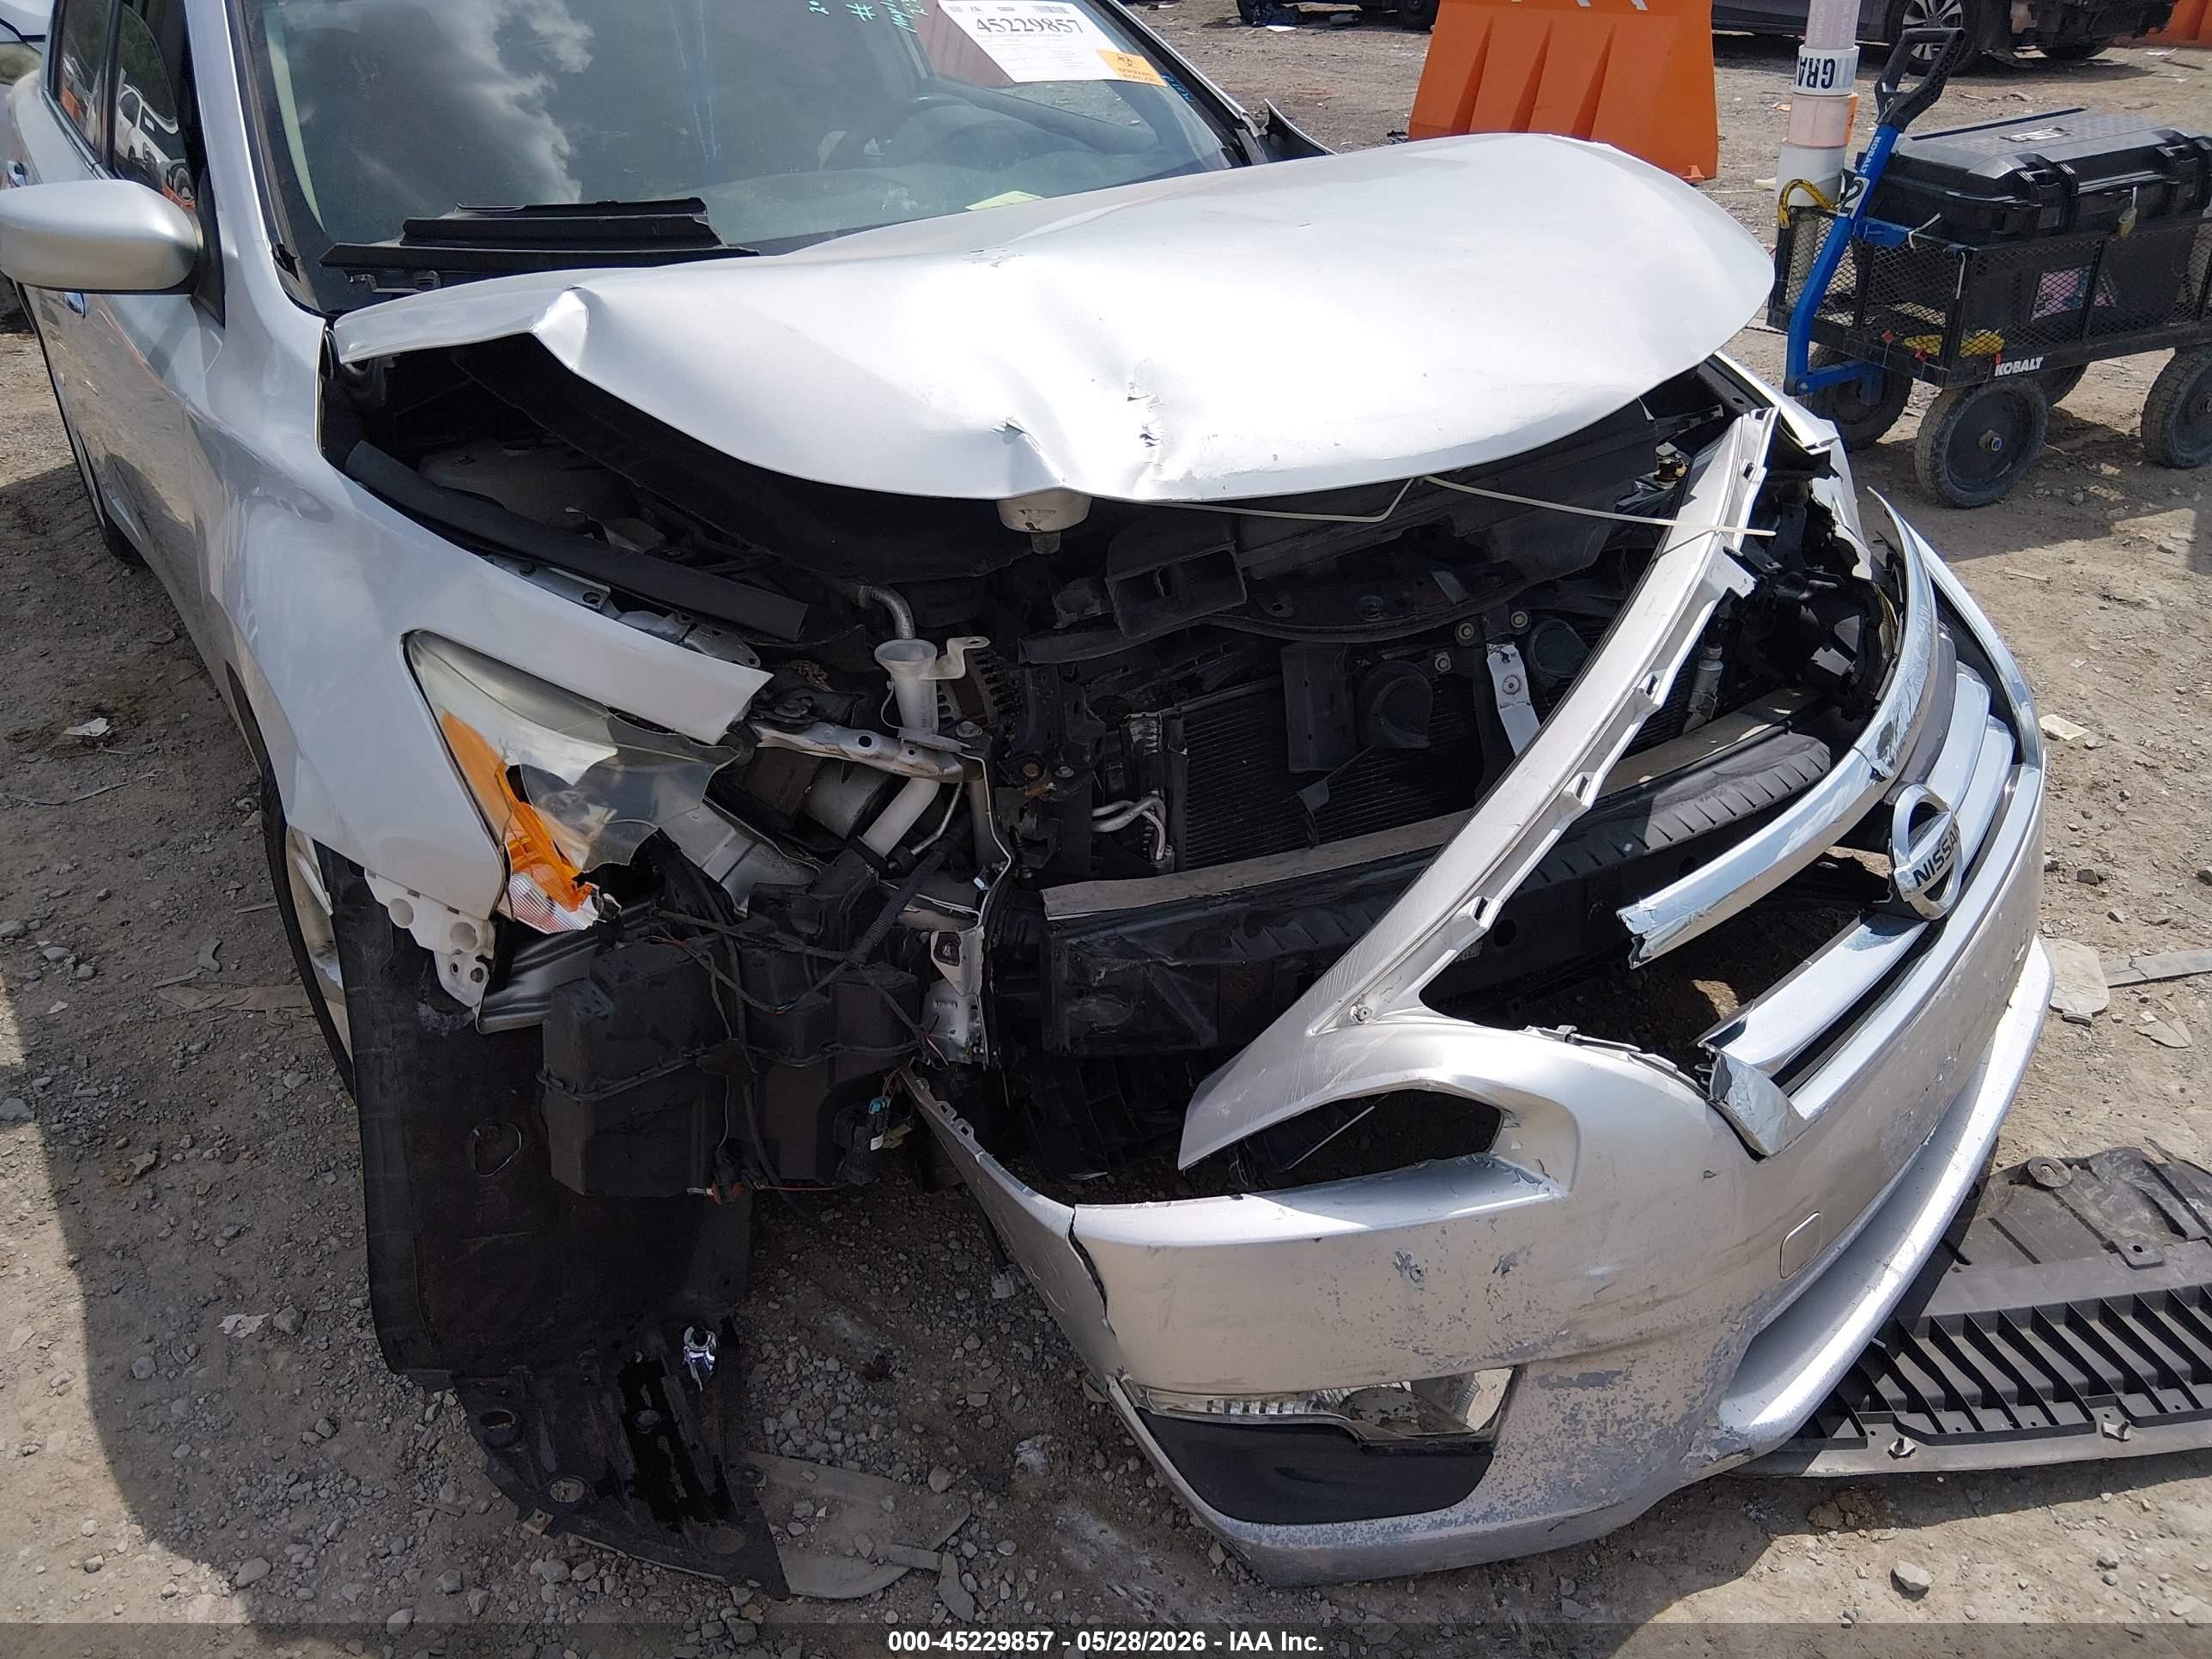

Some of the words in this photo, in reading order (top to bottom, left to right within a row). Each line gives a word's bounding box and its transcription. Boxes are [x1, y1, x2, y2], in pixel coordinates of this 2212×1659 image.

[976, 18, 1084, 33] 45229857
[1859, 137, 1882, 174] KOBALT
[1994, 356, 2044, 377] KOBALT
[1912, 818, 1960, 888] NISSAN
